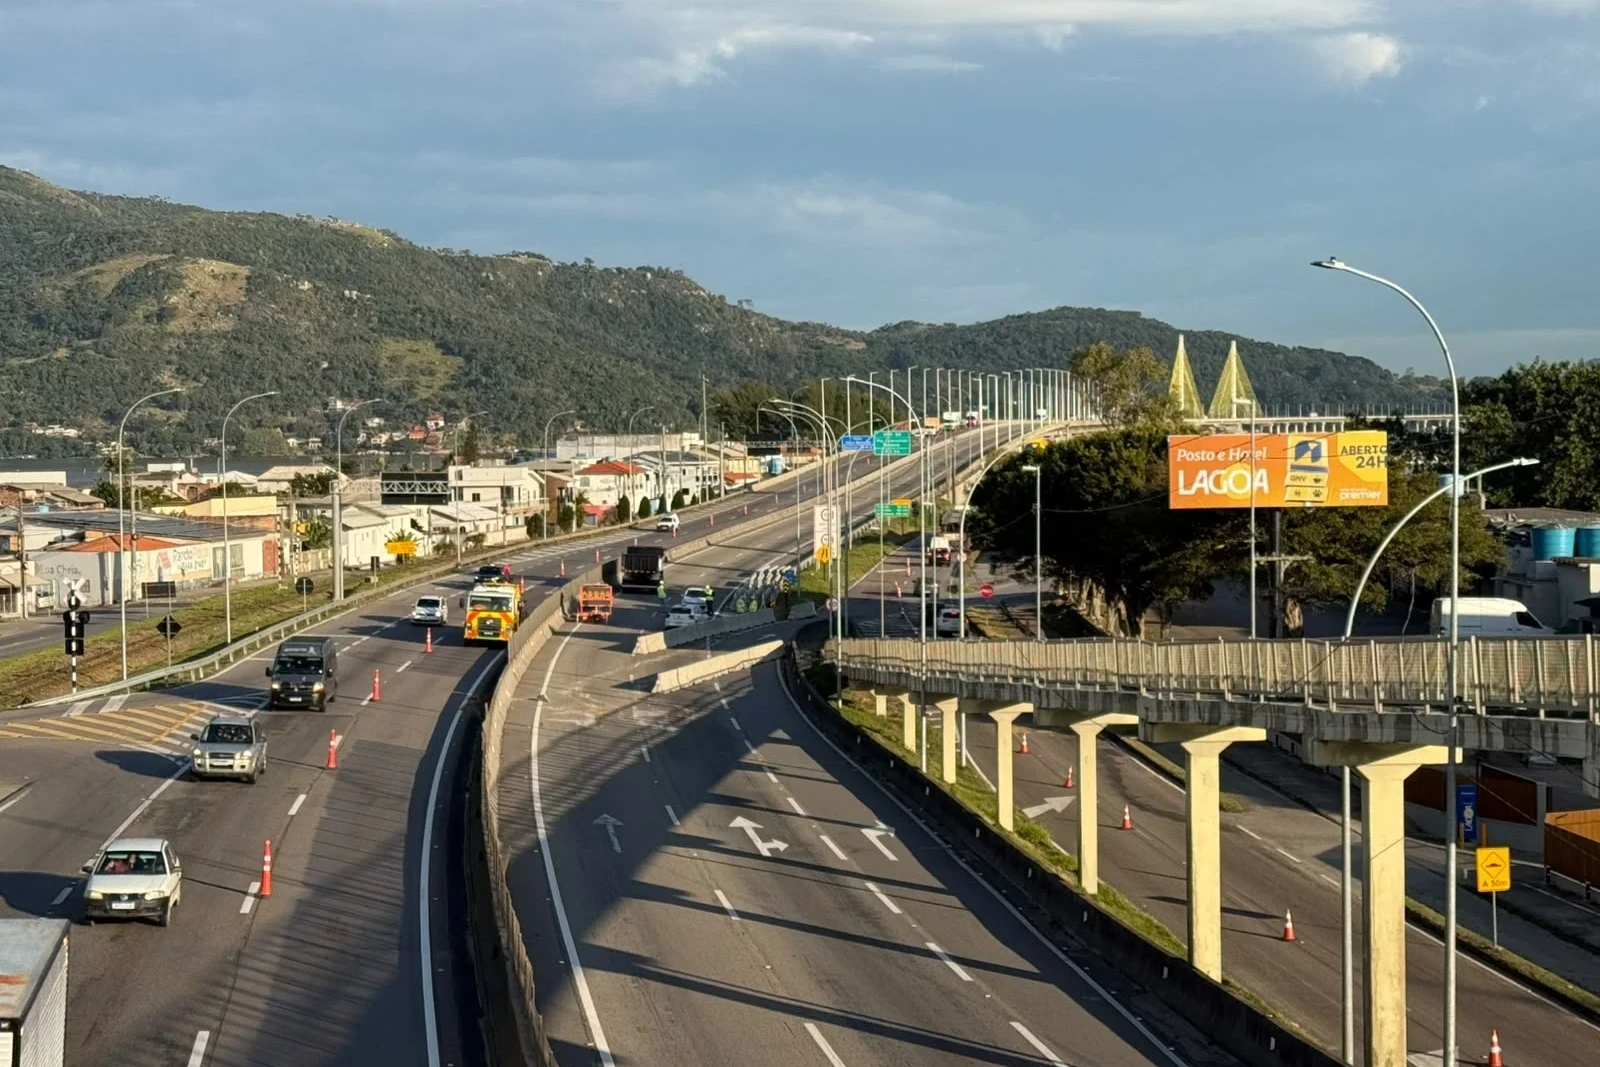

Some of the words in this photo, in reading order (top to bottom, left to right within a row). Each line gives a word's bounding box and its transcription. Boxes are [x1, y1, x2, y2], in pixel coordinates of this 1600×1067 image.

[1176, 448, 1215, 462] Posto
[1217, 451, 1226, 461] e
[1228, 446, 1267, 461] Hoel
[1340, 445, 1388, 456] ABERTO
[1356, 456, 1388, 468] 24H
[1178, 468, 1269, 495] LAGOA
[1491, 879, 1508, 887] 50m
